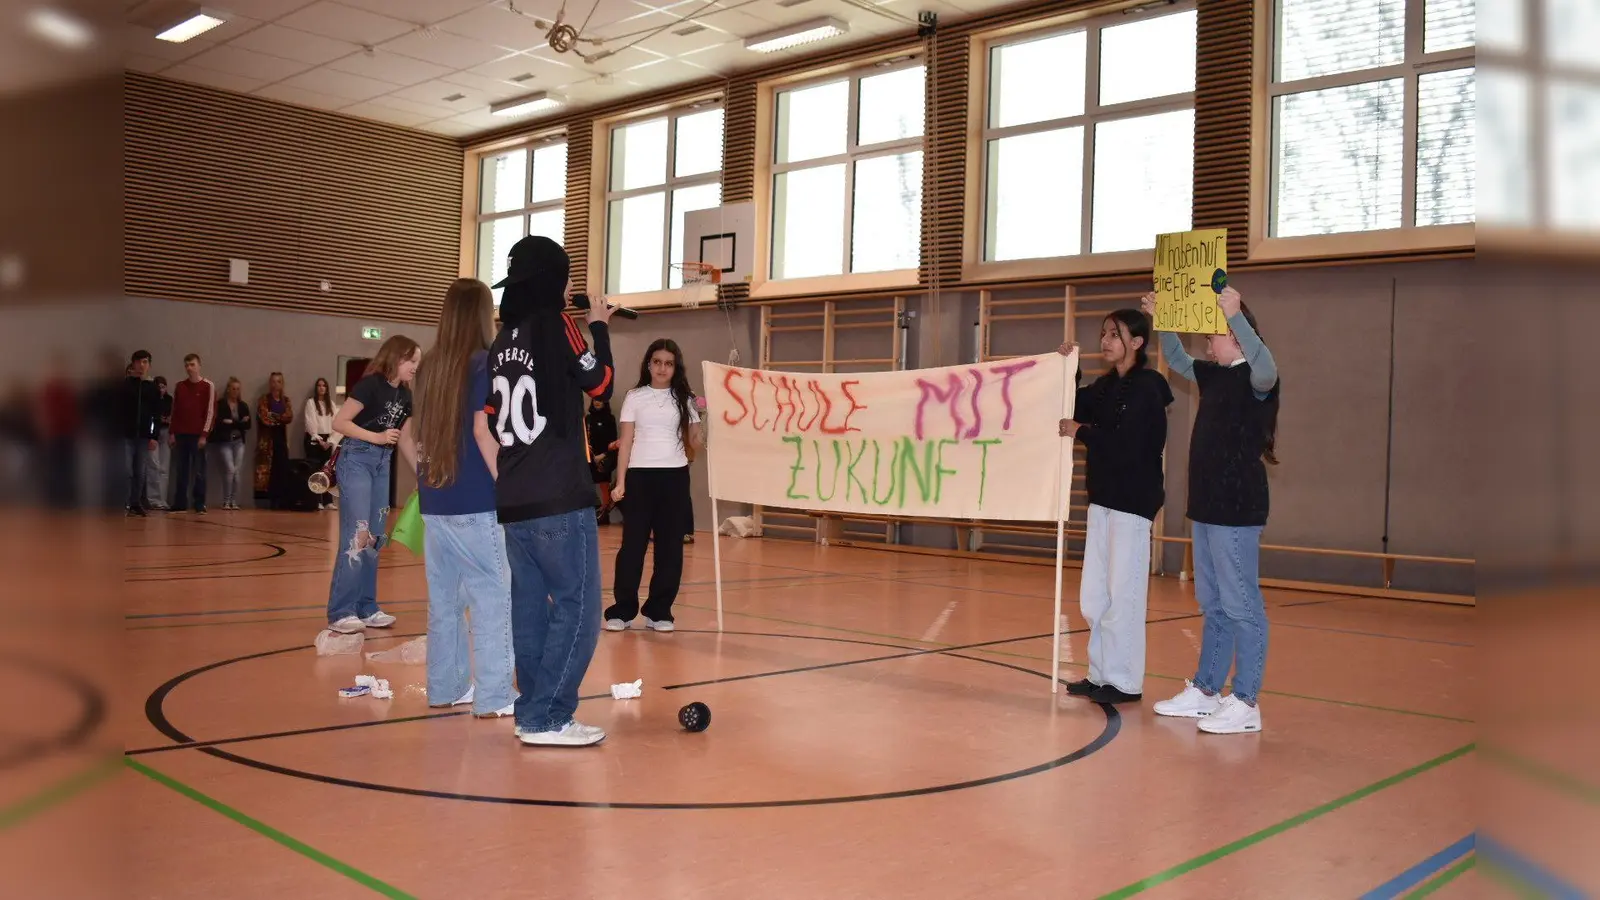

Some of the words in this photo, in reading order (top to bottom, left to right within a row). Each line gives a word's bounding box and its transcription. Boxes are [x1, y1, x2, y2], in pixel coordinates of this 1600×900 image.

[1168, 232, 1199, 272] haben
[1200, 235, 1224, 269] nur
[1153, 274, 1172, 294] eine
[497, 346, 534, 371] PERSIE
[492, 374, 547, 447] 20
[723, 368, 868, 434] SCHULE
[915, 360, 1038, 440] MIT
[781, 435, 1002, 511] ZUKUNFT
